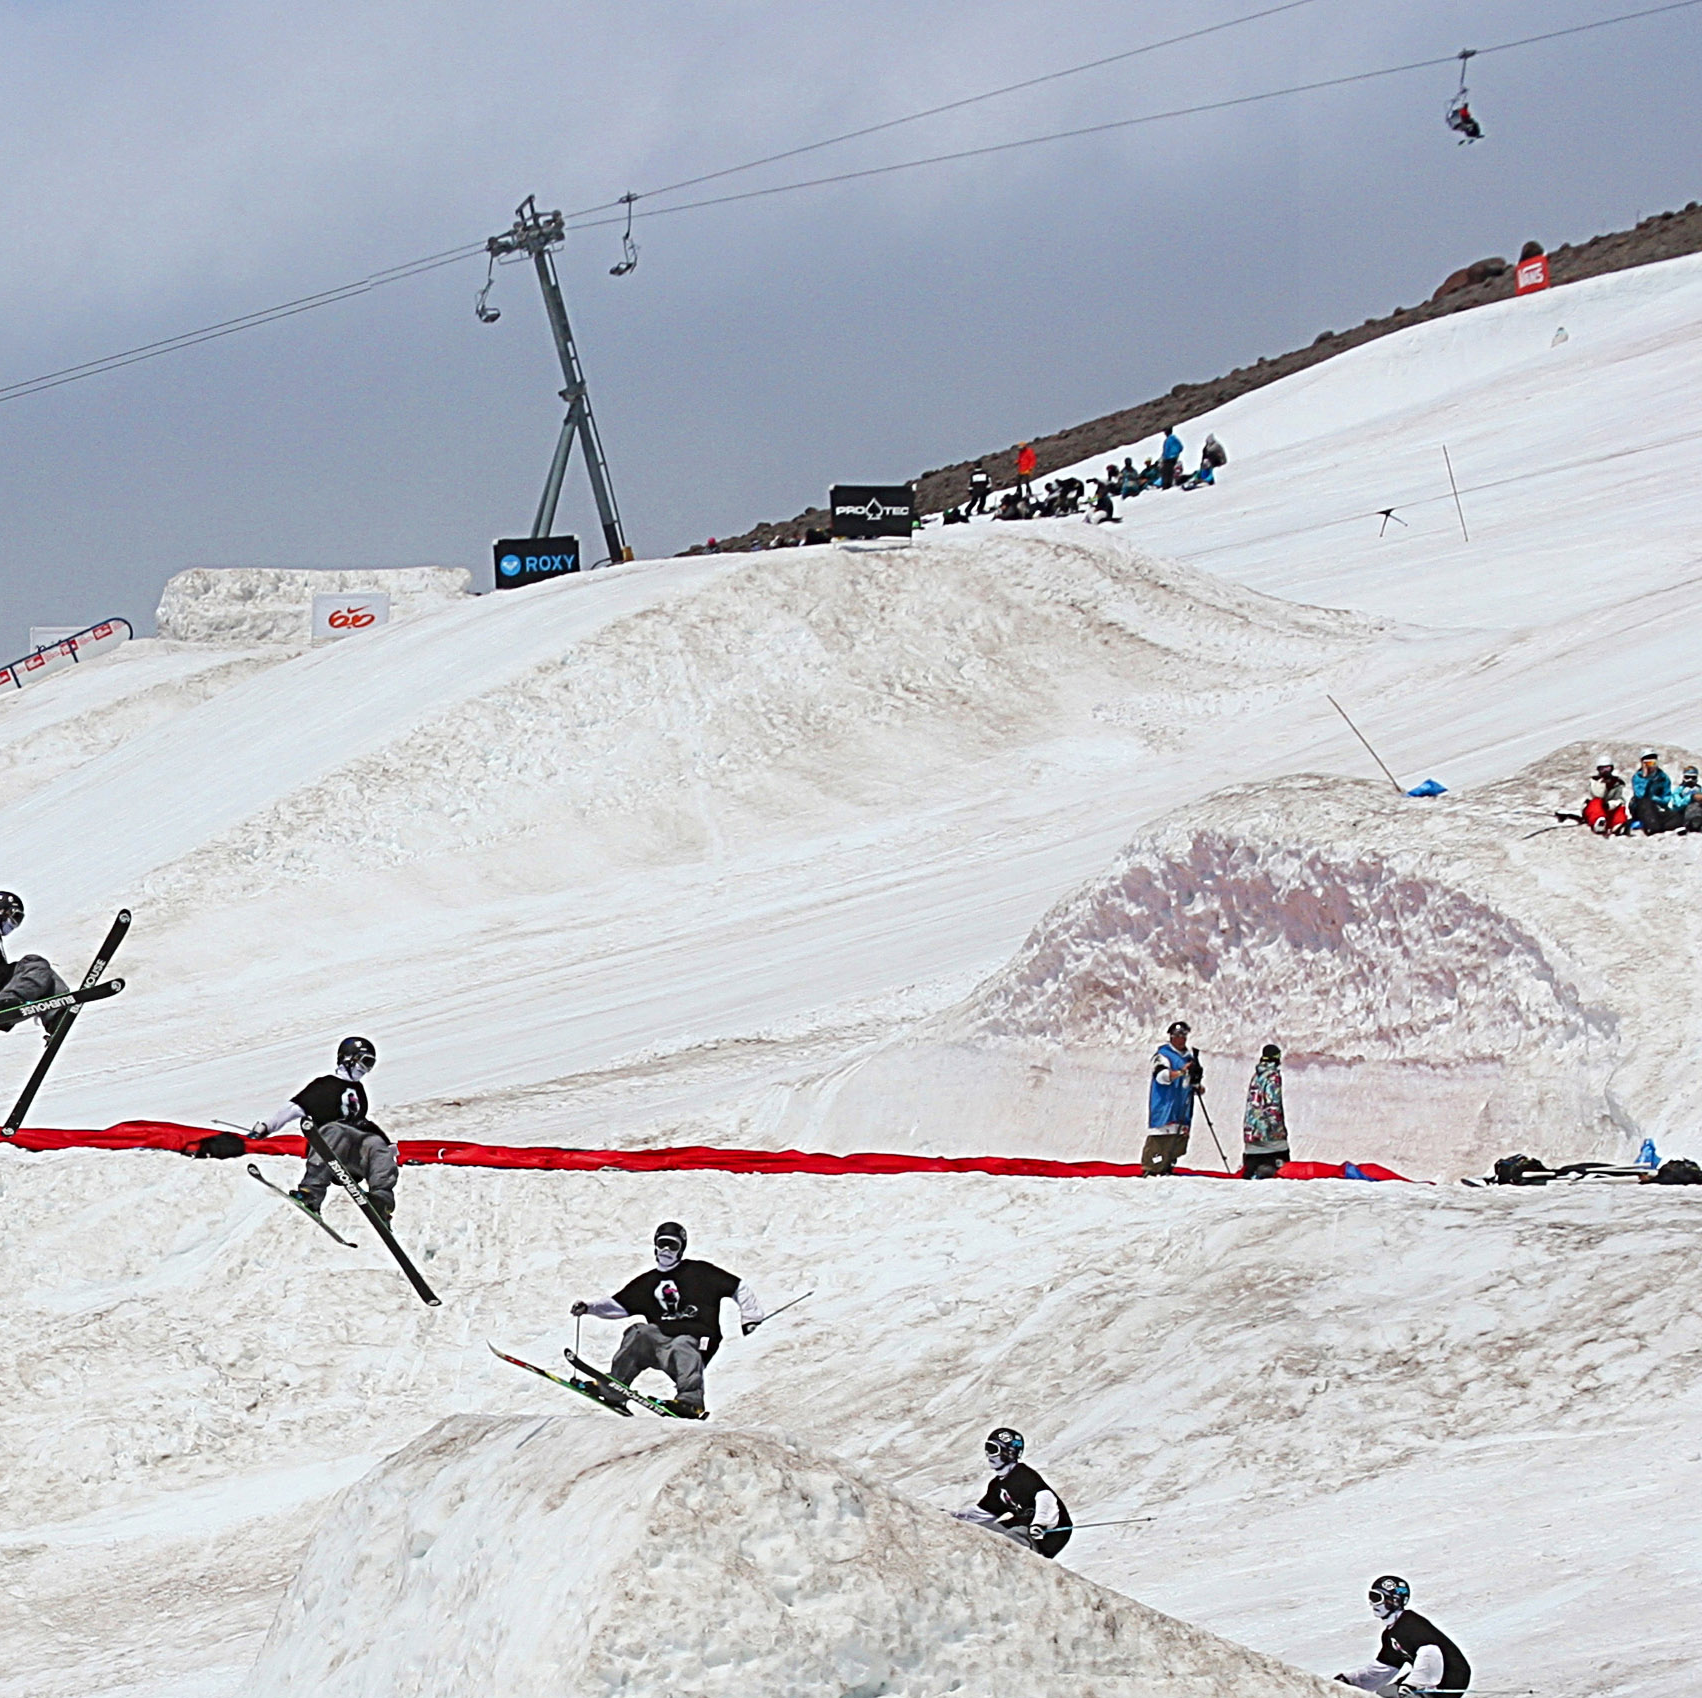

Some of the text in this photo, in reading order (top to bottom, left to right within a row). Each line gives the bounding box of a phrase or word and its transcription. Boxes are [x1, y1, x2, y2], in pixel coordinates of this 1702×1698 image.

[1517, 262, 1544, 289] VANS
[525, 554, 575, 573] ROXY
[19, 995, 76, 1016] BLUEHOUSE
